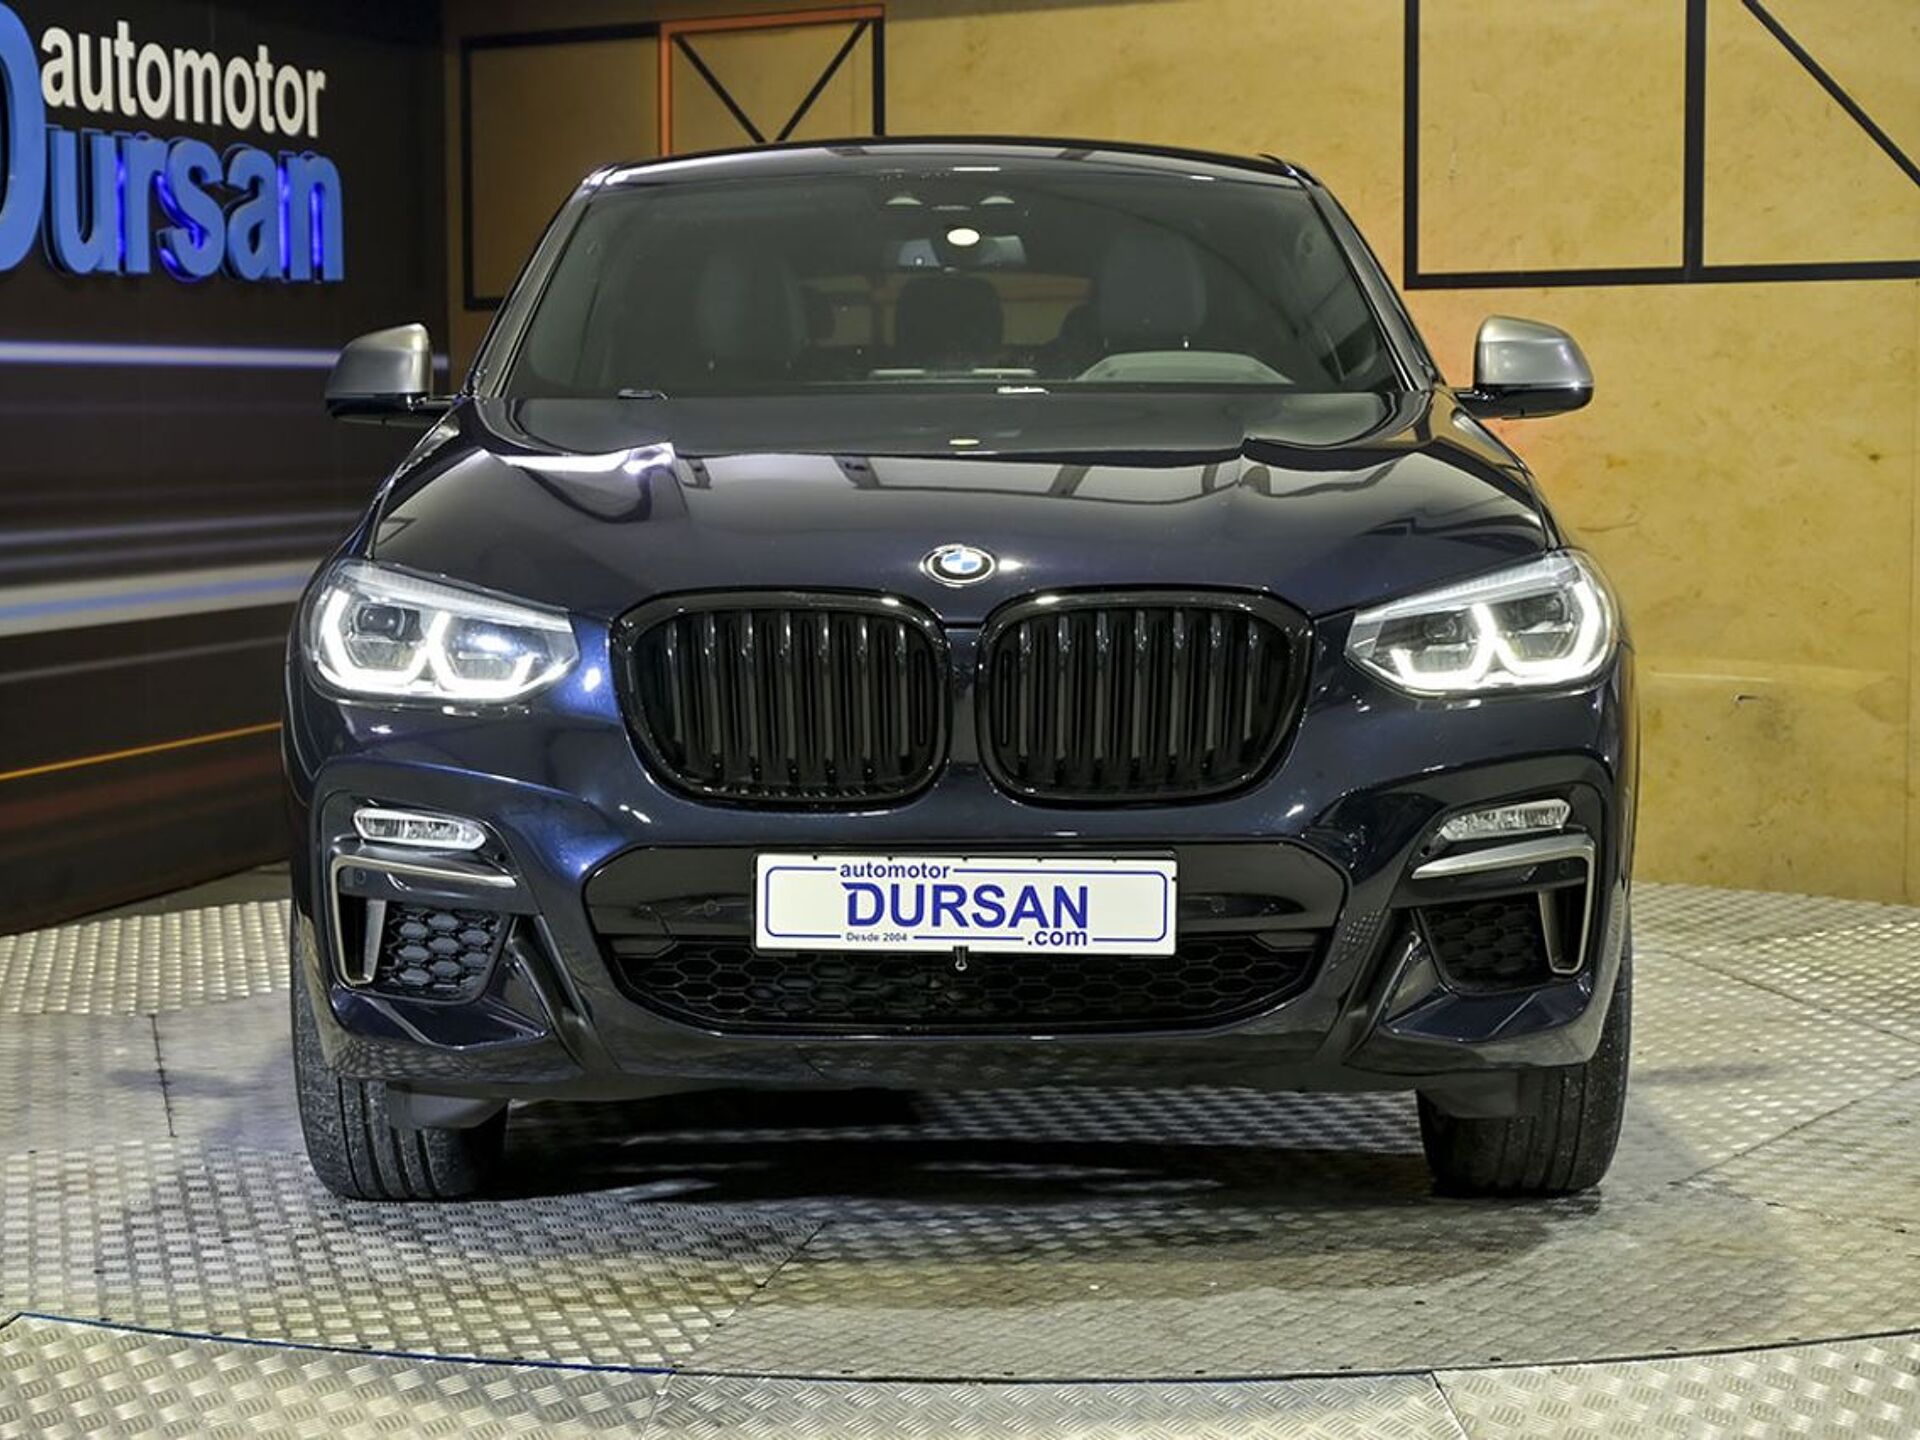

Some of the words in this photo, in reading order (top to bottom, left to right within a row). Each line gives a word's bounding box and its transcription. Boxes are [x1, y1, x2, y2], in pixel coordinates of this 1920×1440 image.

[40, 20, 326, 138] automotor
[840, 862, 951, 879] automotor
[842, 882, 1088, 928] DURSAN
[846, 932, 880, 942] Desde
[1027, 930, 1088, 946] .com
